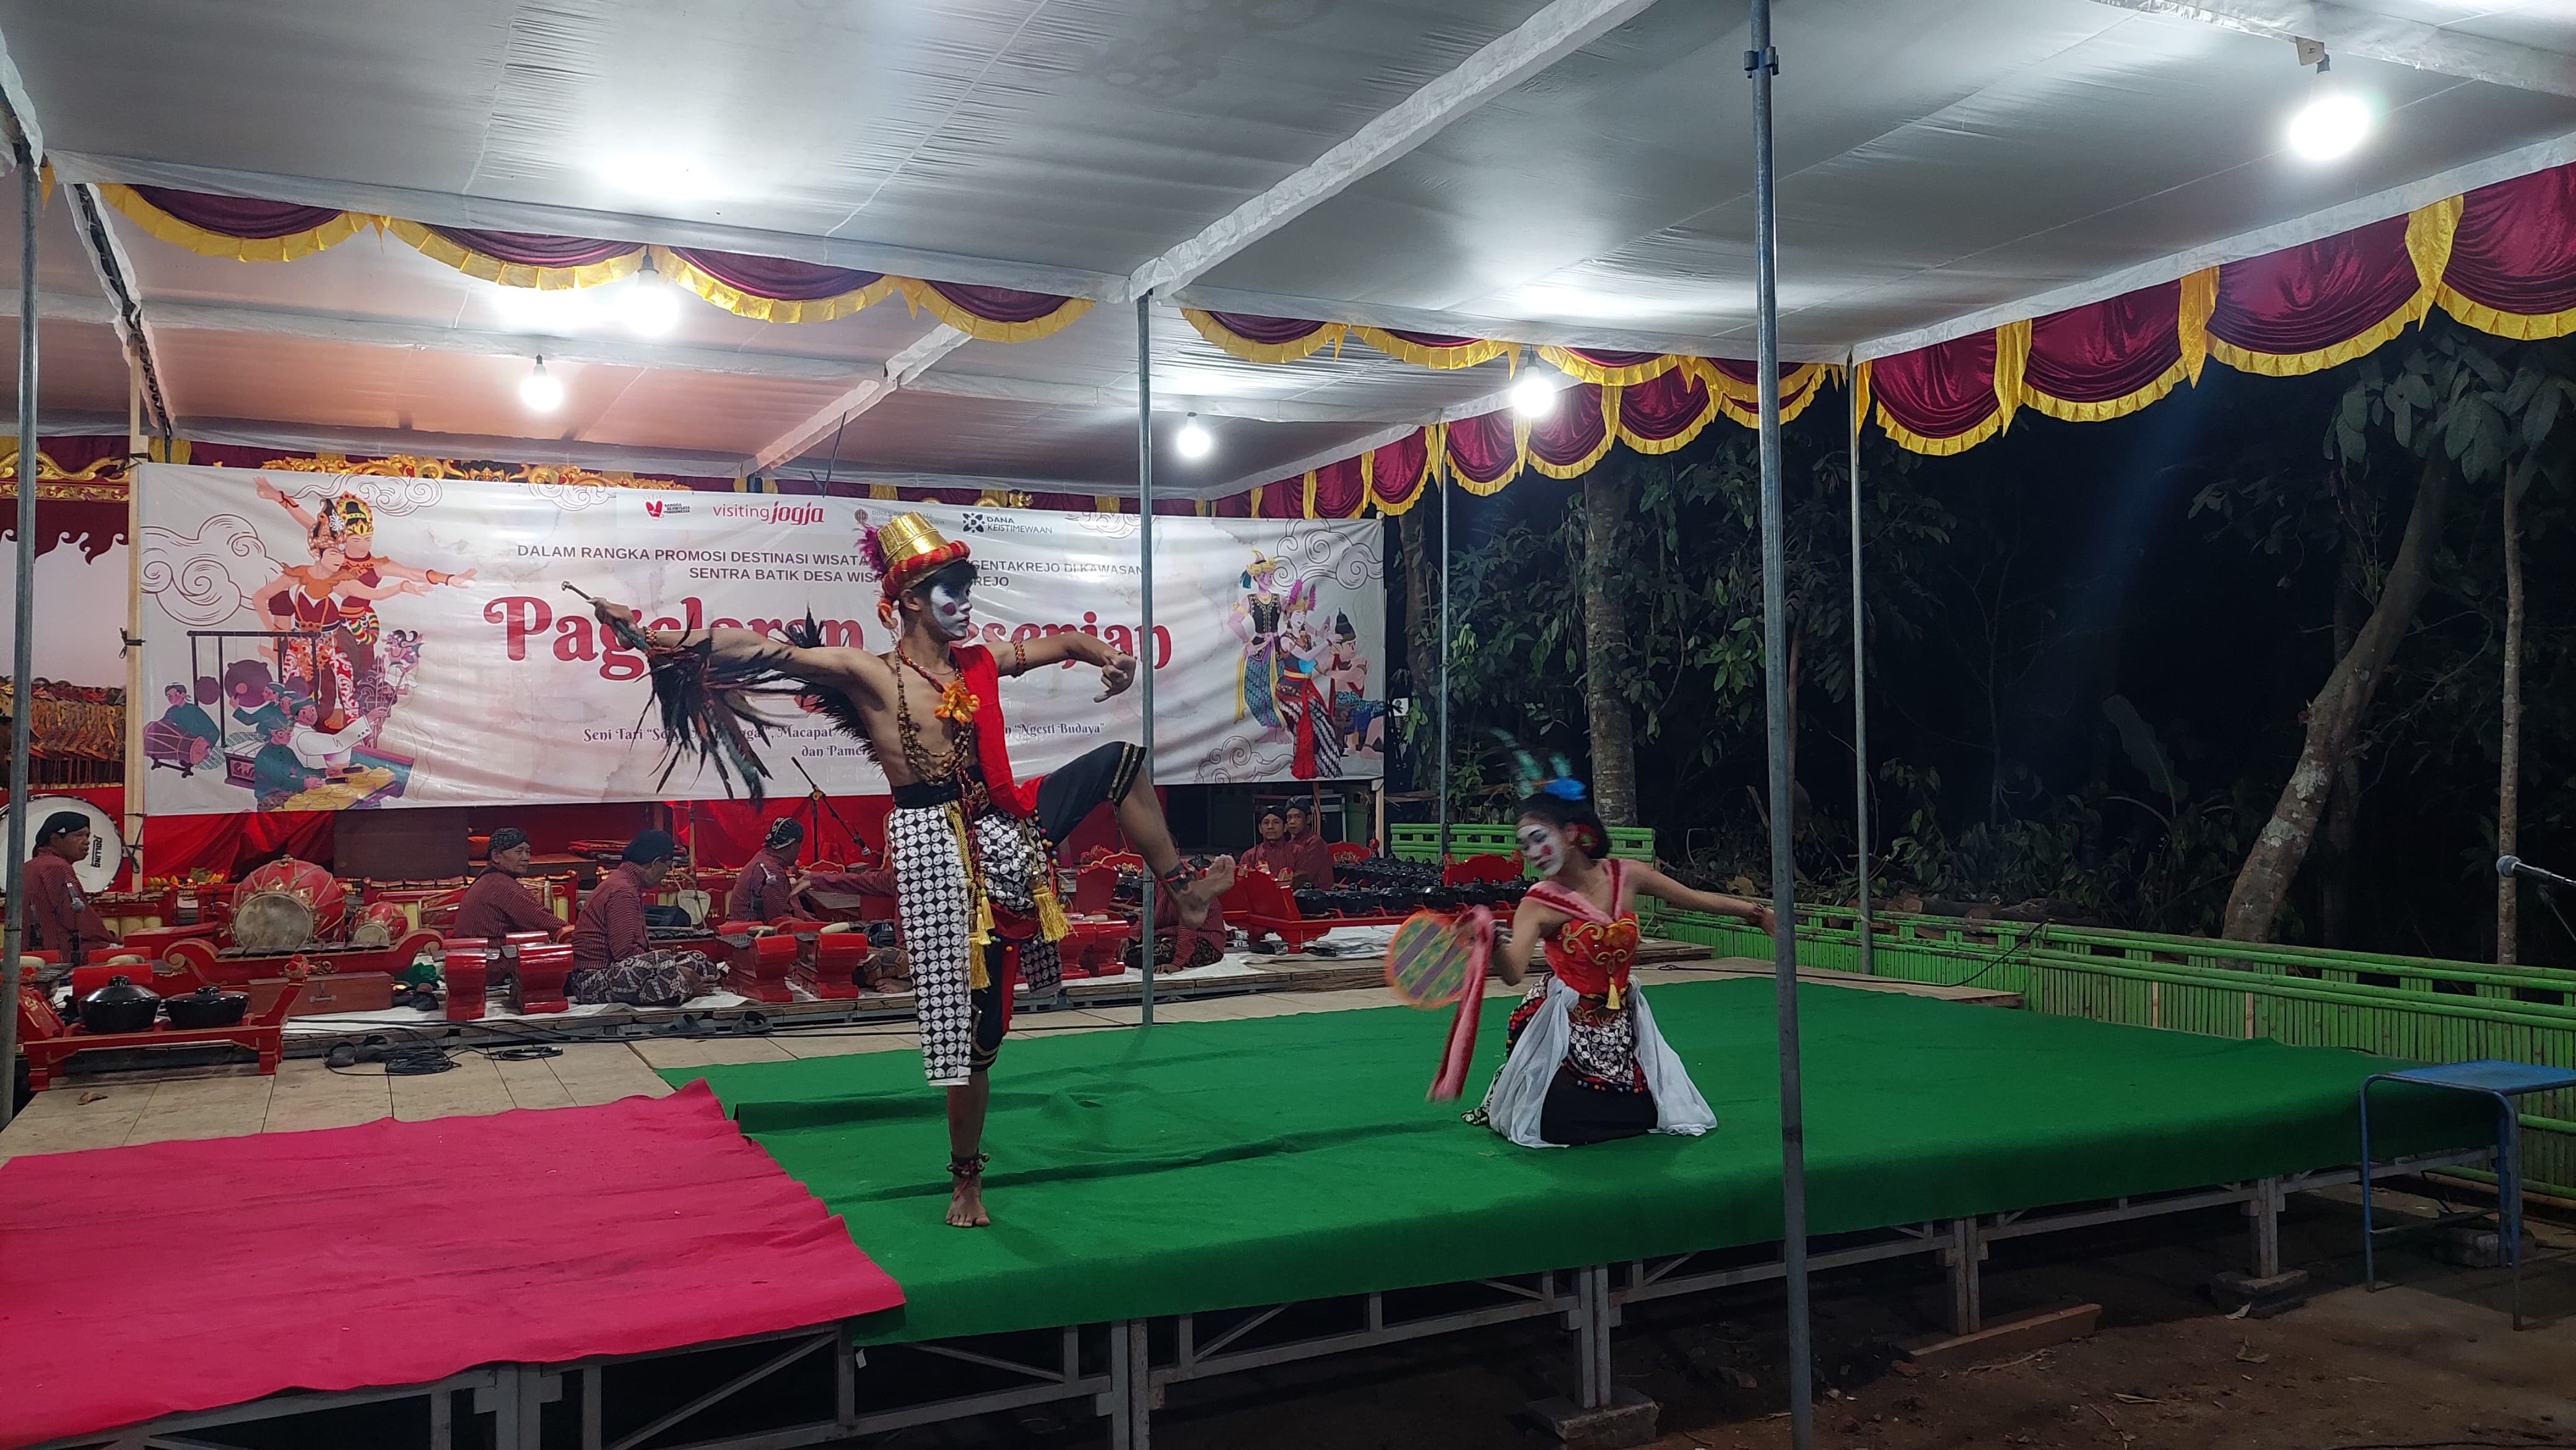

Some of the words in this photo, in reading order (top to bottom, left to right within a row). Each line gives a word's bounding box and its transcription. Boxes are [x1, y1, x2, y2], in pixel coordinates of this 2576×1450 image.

[986, 516, 1014, 524] DANA
[987, 524, 1053, 534] KEISTIMEWAAN
[517, 545, 576, 558] DALAM
[581, 547, 650, 560] RANGKA
[655, 549, 726, 562] PROMOSI
[731, 551, 808, 565] DESTINASI
[812, 554, 869, 566] WISATA
[968, 560, 1060, 573] GENTAKREJO
[1064, 563, 1076, 572] DI
[689, 567, 751, 580] SENTRA
[755, 569, 800, 581] BATIK
[804, 570, 843, 582] DESA
[972, 576, 1009, 587] REJO
[584, 728, 612, 742] Seni
[616, 728, 643, 740] Tari
[777, 724, 833, 740] Macapat
[801, 745, 824, 757] dan
[91, 835, 102, 868] ROLLING
